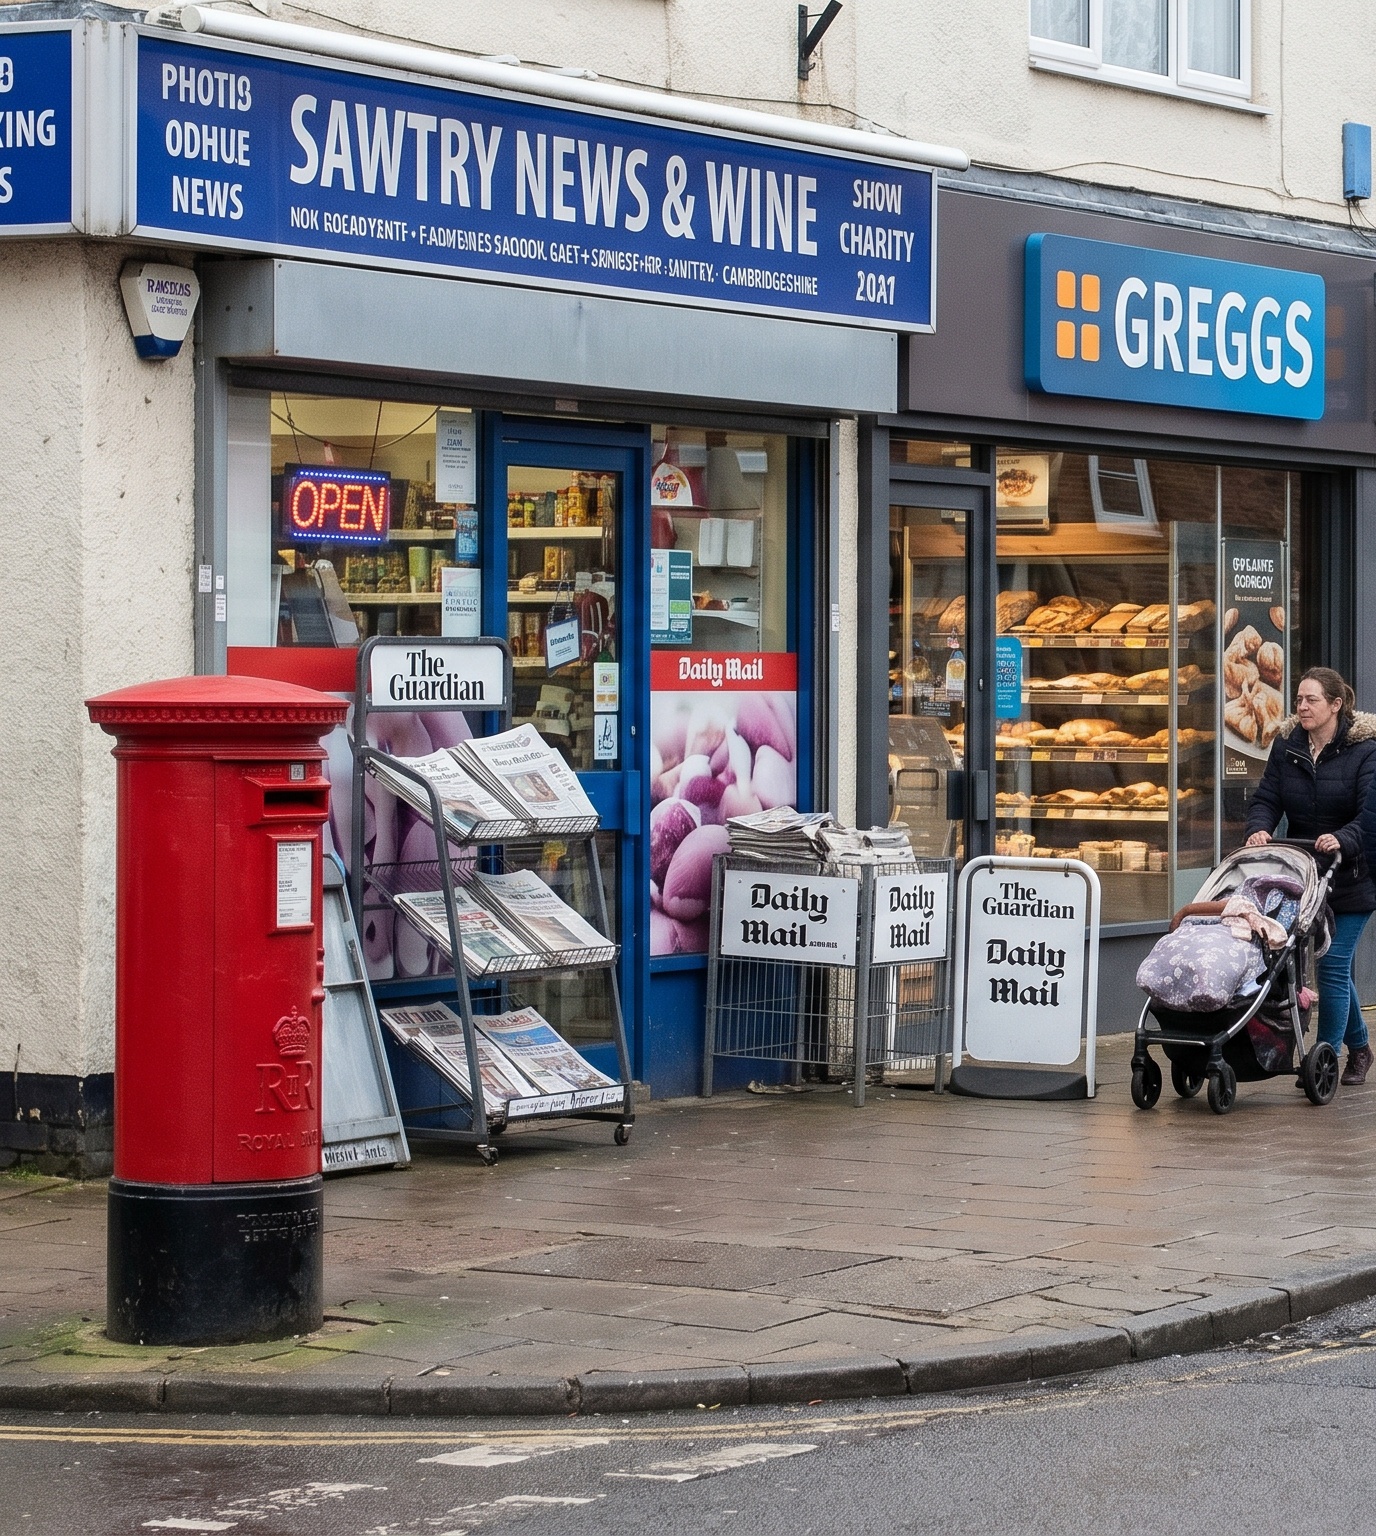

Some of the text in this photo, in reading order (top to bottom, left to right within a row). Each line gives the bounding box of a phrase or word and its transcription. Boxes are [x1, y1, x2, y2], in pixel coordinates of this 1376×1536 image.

[290, 94, 818, 256] SAWTRY NEWS & WINE
[172, 175, 244, 220] NEWS
[853, 179, 903, 215] SHOW
[290, 206, 319, 231] NOK
[839, 222, 915, 263] CHARITY
[1114, 276, 1314, 389] GREGGS
[292, 480, 386, 532] OPEN
[406, 649, 444, 677] The
[678, 657, 764, 687] Daily Mail
[389, 673, 485, 701] Guardian
[750, 883, 829, 925] Daily
[888, 884, 934, 920] Daily
[999, 882, 1037, 902] The
[982, 897, 1075, 920] Guardian
[740, 920, 808, 948] Mail
[889, 921, 930, 949] Mail
[986, 938, 1066, 978] Daily
[988, 977, 1060, 1008] Mail
[237, 1133, 295, 1151] ROYAL
